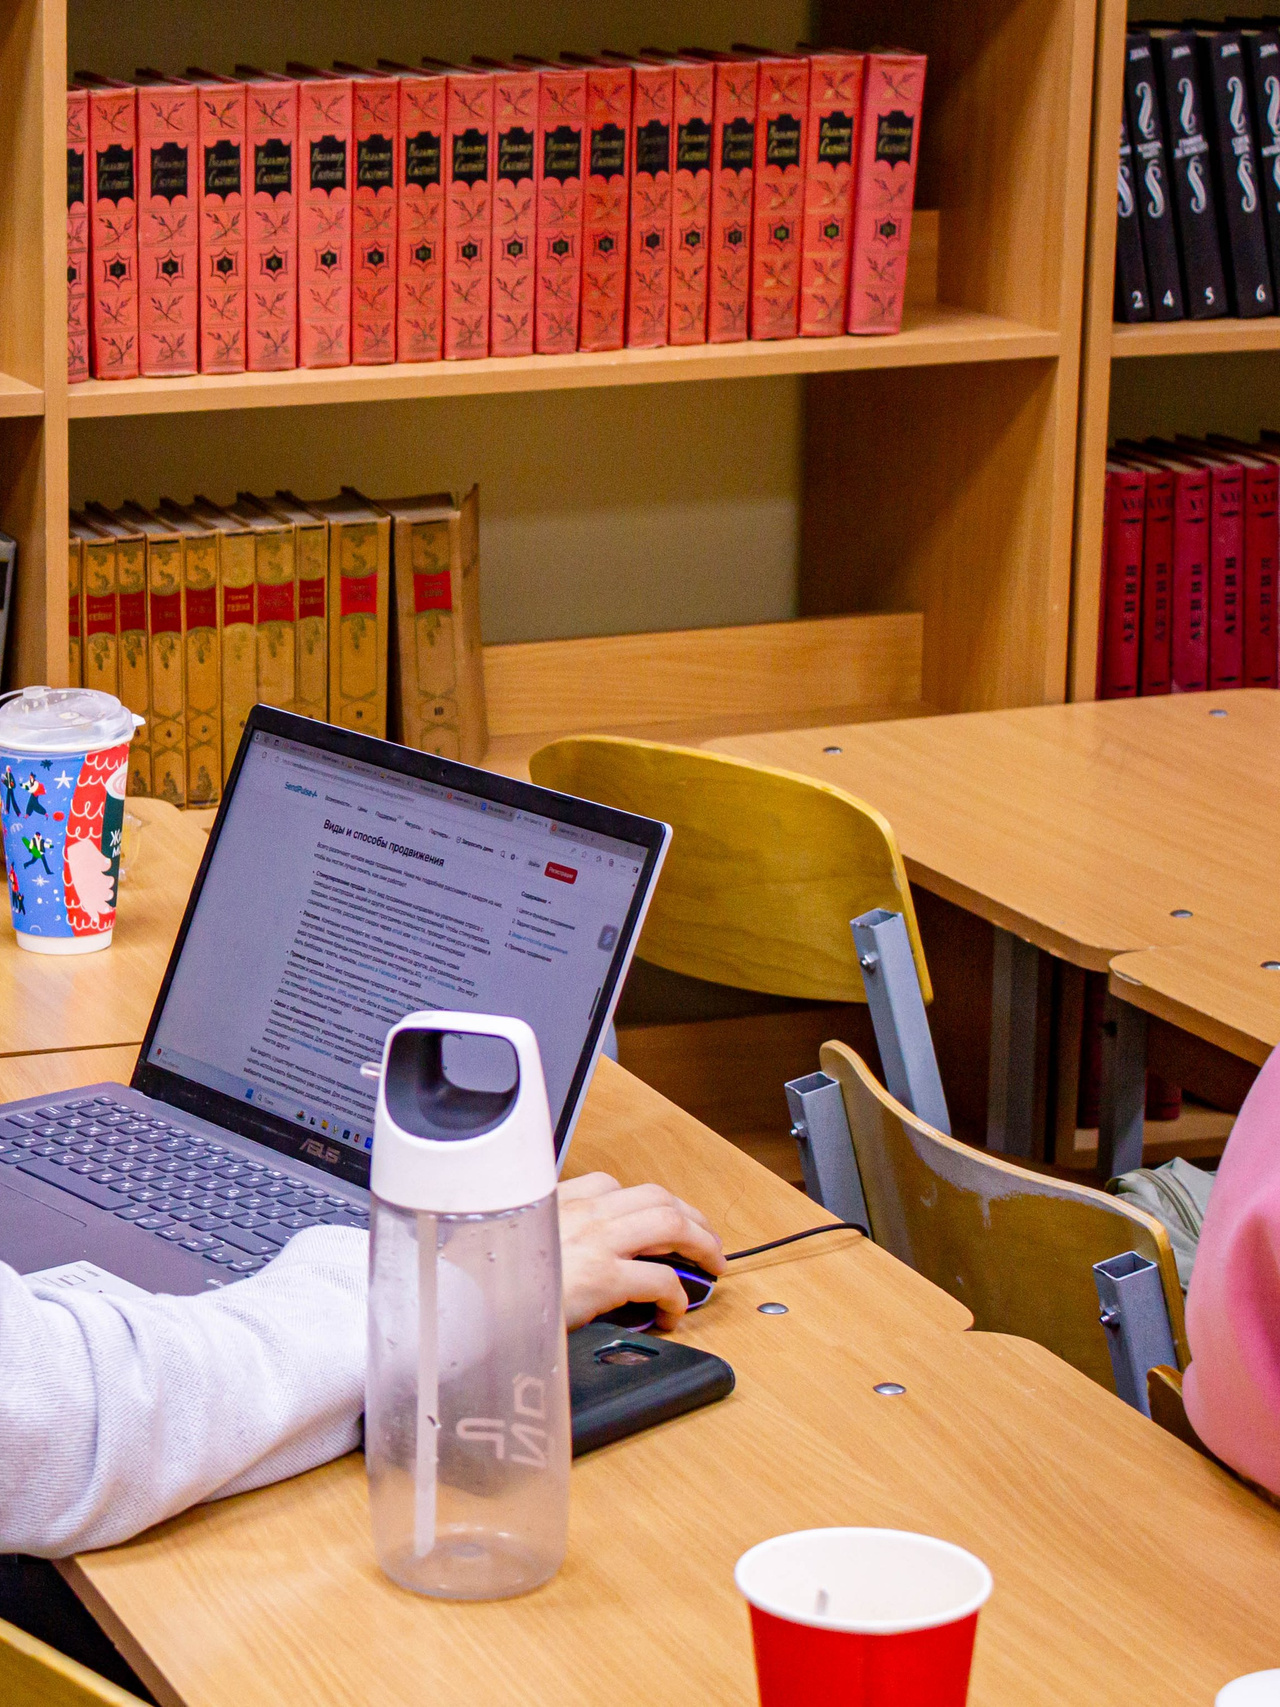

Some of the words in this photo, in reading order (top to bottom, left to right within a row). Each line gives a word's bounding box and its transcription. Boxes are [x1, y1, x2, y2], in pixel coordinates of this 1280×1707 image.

[1131, 290, 1144, 309] 2
[1162, 290, 1174, 307] 4
[1204, 286, 1215, 305] 5
[1255, 284, 1266, 303] 6
[322, 819, 345, 835] Виды
[345, 828, 352, 836] и
[352, 828, 388, 848] способы
[387, 841, 445, 867] продвижения
[299, 1138, 341, 1164] ASUS
